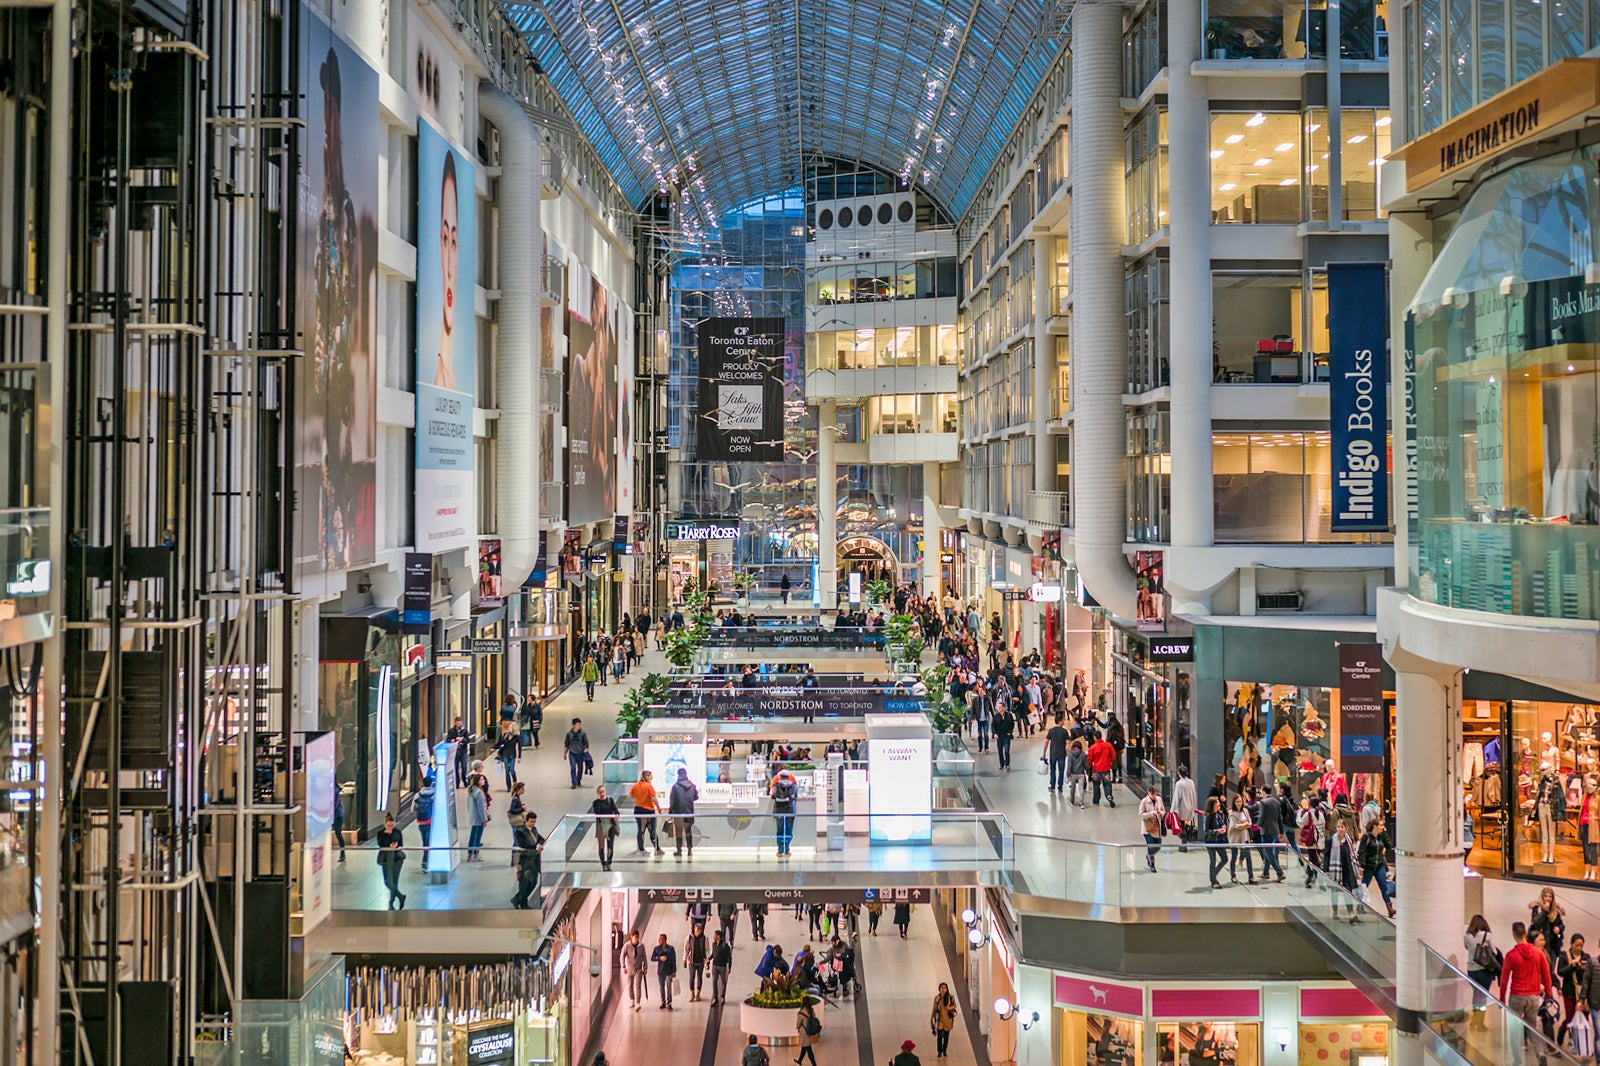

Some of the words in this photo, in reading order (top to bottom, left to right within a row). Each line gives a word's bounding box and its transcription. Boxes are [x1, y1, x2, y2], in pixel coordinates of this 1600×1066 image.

[1440, 99, 1540, 172] IMAGINATION
[1552, 291, 1577, 320] Books
[709, 336, 745, 346] Toronto
[747, 336, 774, 346] Eaton
[722, 362, 760, 371] PROUDLY
[718, 371, 764, 380] WELCOMES
[1344, 349, 1373, 432] Books
[730, 436, 750, 444] NOW
[729, 445, 752, 453] OPEN
[1339, 439, 1380, 520] Indigo
[678, 525, 710, 540] HARRY
[709, 525, 740, 539] ROSEN
[773, 635, 819, 643] NORDSTROM
[1152, 645, 1190, 655] J.CREW
[716, 702, 754, 710] WELCOMES
[760, 700, 824, 710] NORDSTROM
[828, 702, 839, 710] TO
[839, 702, 873, 710] TORONTO
[888, 702, 905, 710] NOW
[764, 889, 792, 899] Queen
[793, 889, 804, 898] St.
[468, 1036, 514, 1055] CRYSTALDUST
